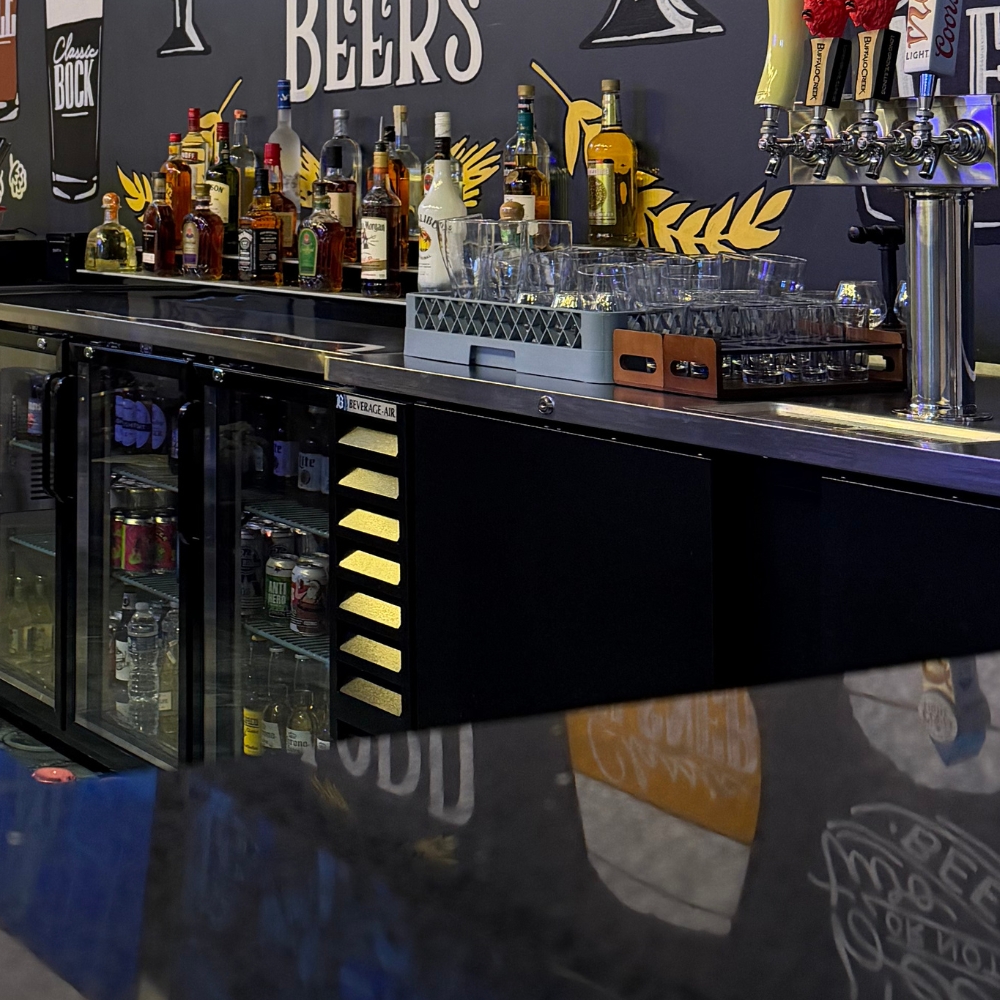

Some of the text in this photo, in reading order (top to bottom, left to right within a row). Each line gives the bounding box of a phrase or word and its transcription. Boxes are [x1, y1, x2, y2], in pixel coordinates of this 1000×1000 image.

[53, 32, 98, 63] Classic
[906, 50, 929, 60] LIGHT
[54, 59, 94, 110] BOCK
[364, 221, 385, 232] Morgan
[268, 580, 287, 594] ANTI
[268, 592, 287, 605] HERO
